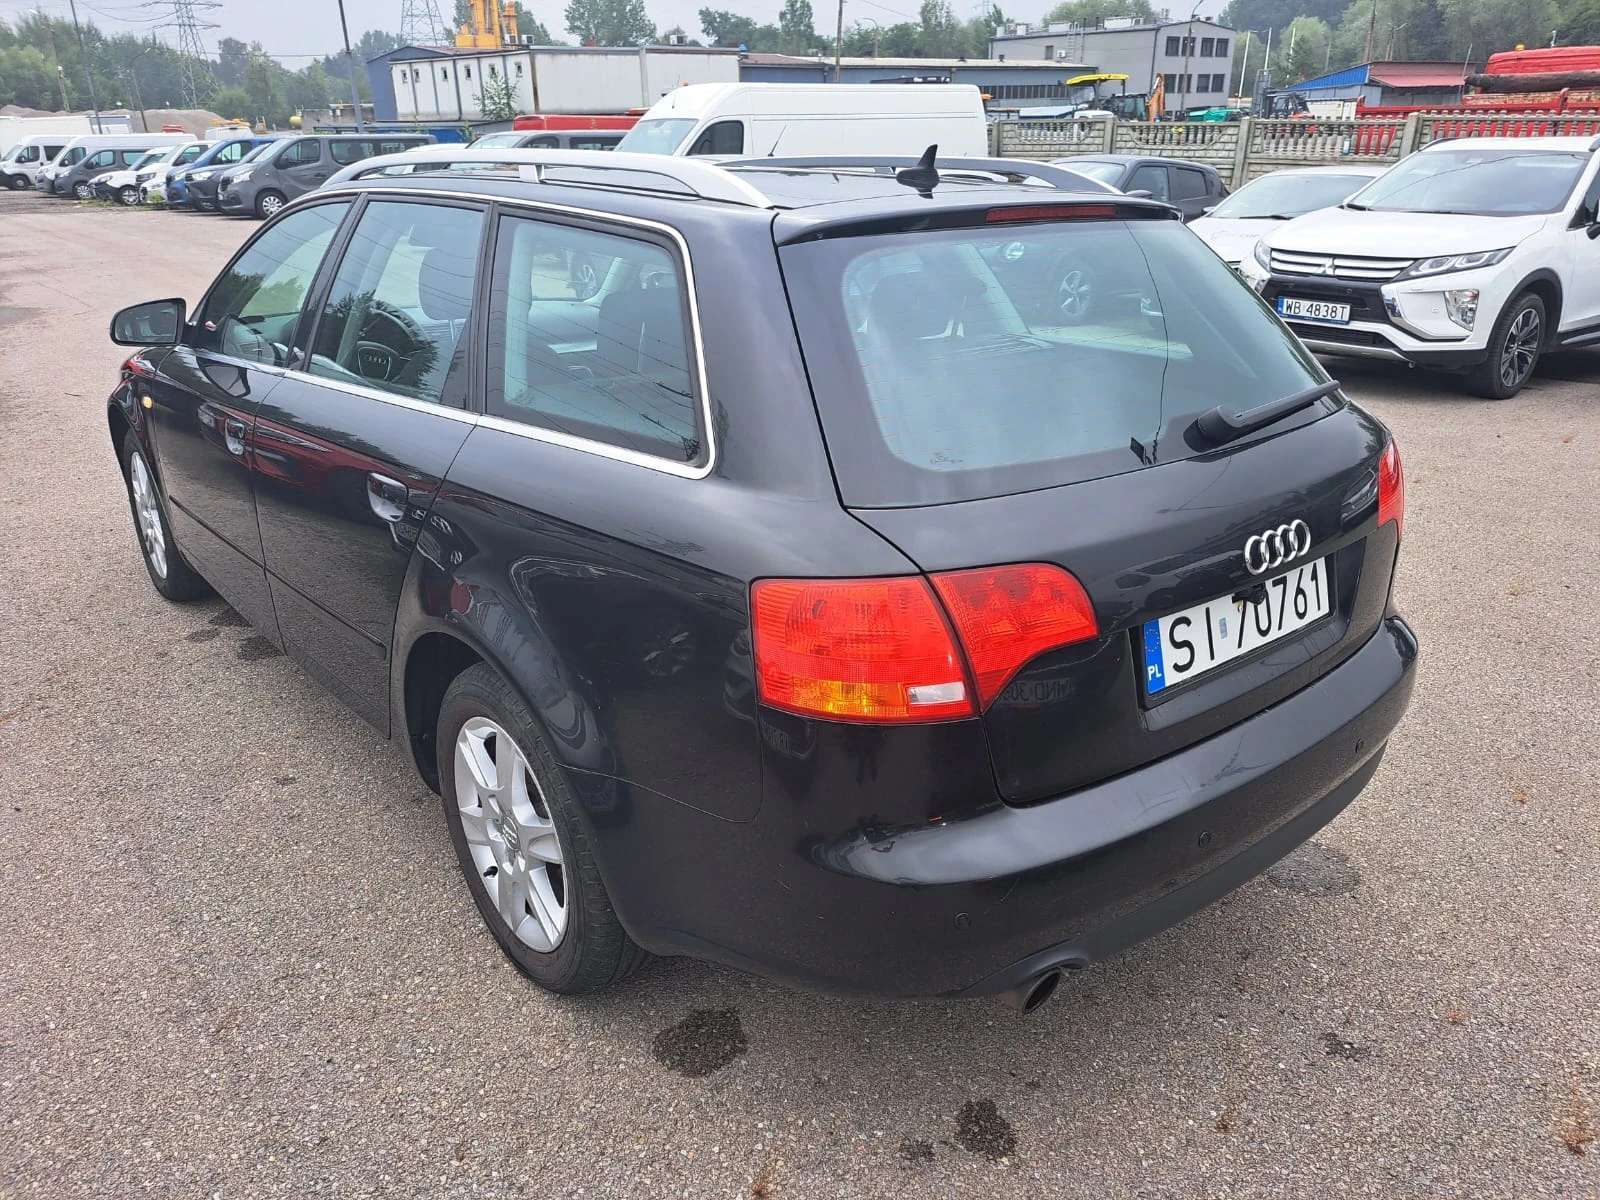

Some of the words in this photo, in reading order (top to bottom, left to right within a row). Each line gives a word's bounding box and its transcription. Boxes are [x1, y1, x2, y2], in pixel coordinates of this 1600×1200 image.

[1286, 300, 1301, 315] WB
[1306, 303, 1347, 320] 4838T
[1169, 607, 1215, 674] SI
[1148, 664, 1162, 681] PL
